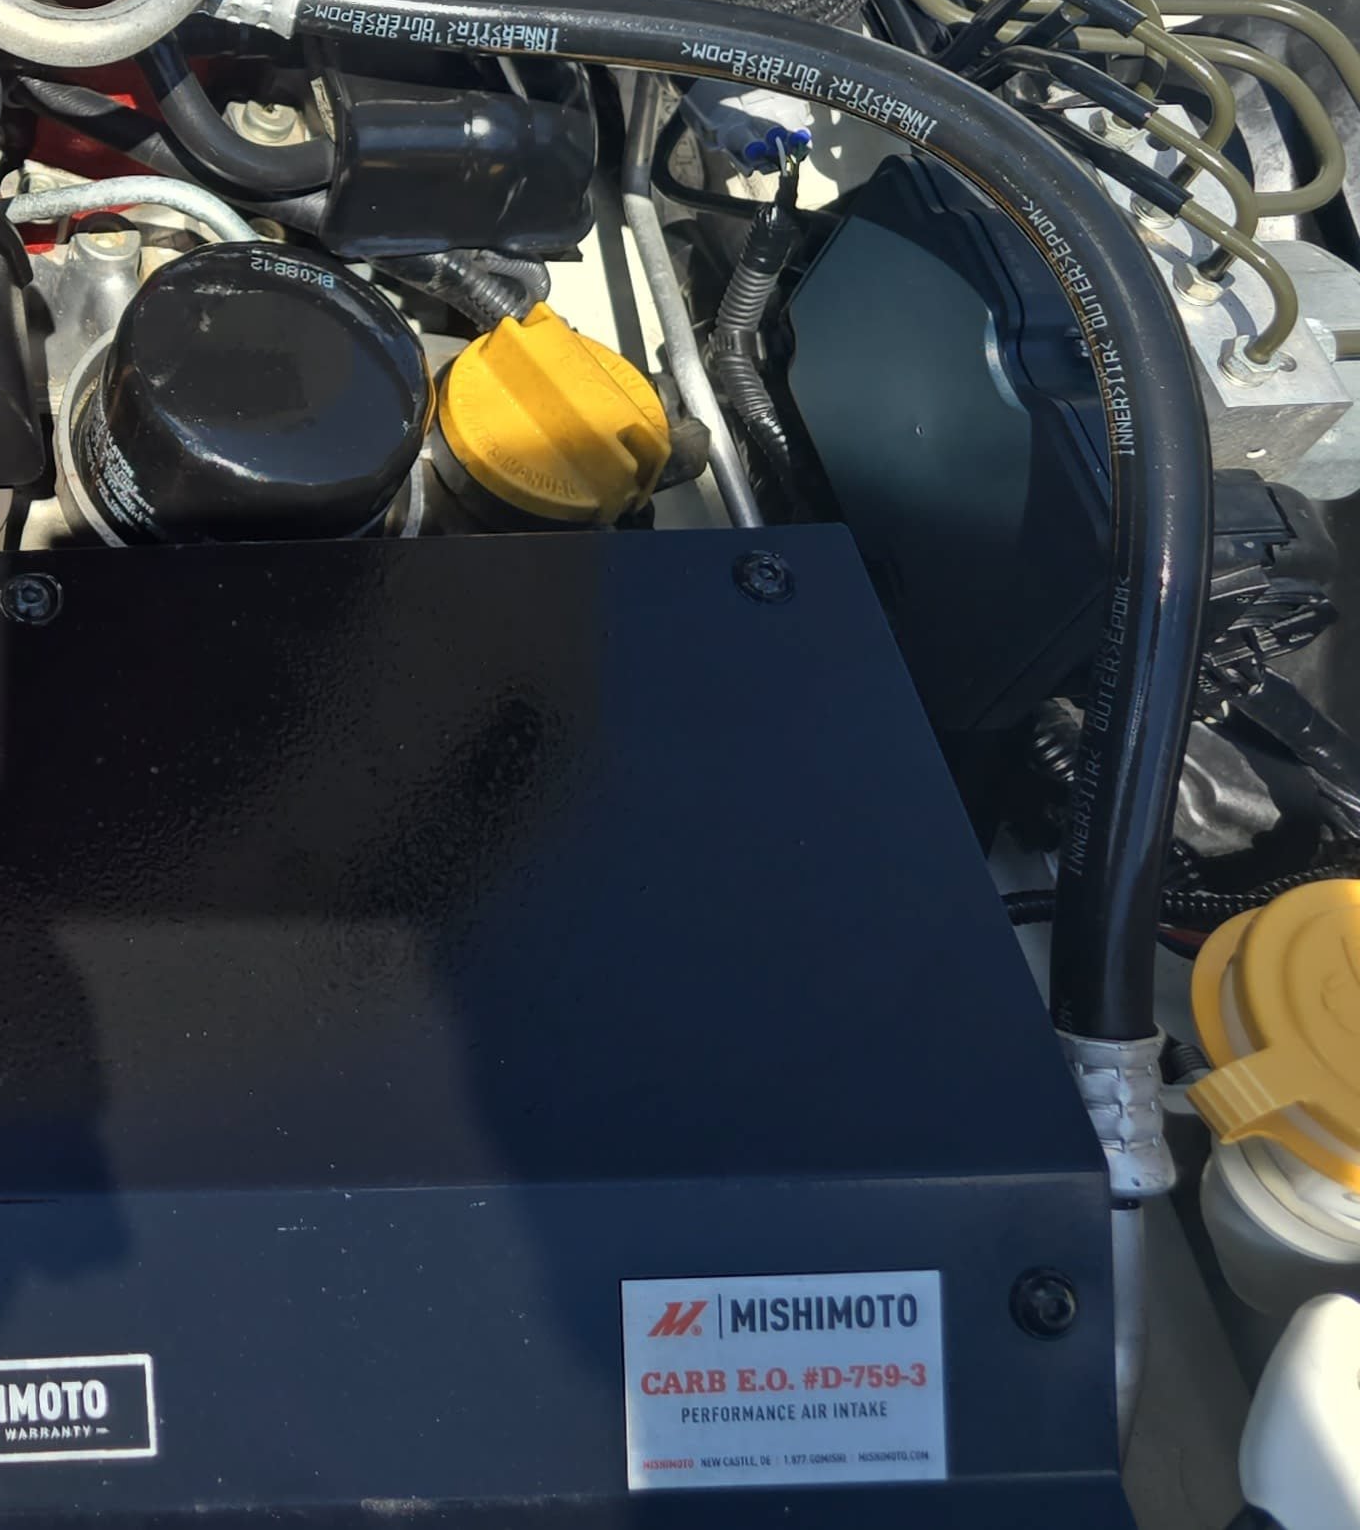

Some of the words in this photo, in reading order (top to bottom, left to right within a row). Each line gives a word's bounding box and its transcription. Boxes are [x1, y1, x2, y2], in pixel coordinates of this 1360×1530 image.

[250, 256, 335, 289] BK08B12
[730, 1293, 918, 1334] MISHIMOTO
[640, 1369, 727, 1396] CARB
[736, 1367, 795, 1393] E.O.
[802, 1362, 927, 1390] #D-759-3
[681, 1404, 797, 1425] PERFORMANCE
[801, 1402, 828, 1420] AIR
[833, 1400, 889, 1418] INTAKE
[4, 1424, 92, 1442] WARRANTY
[700, 1456, 721, 1469] NEW
